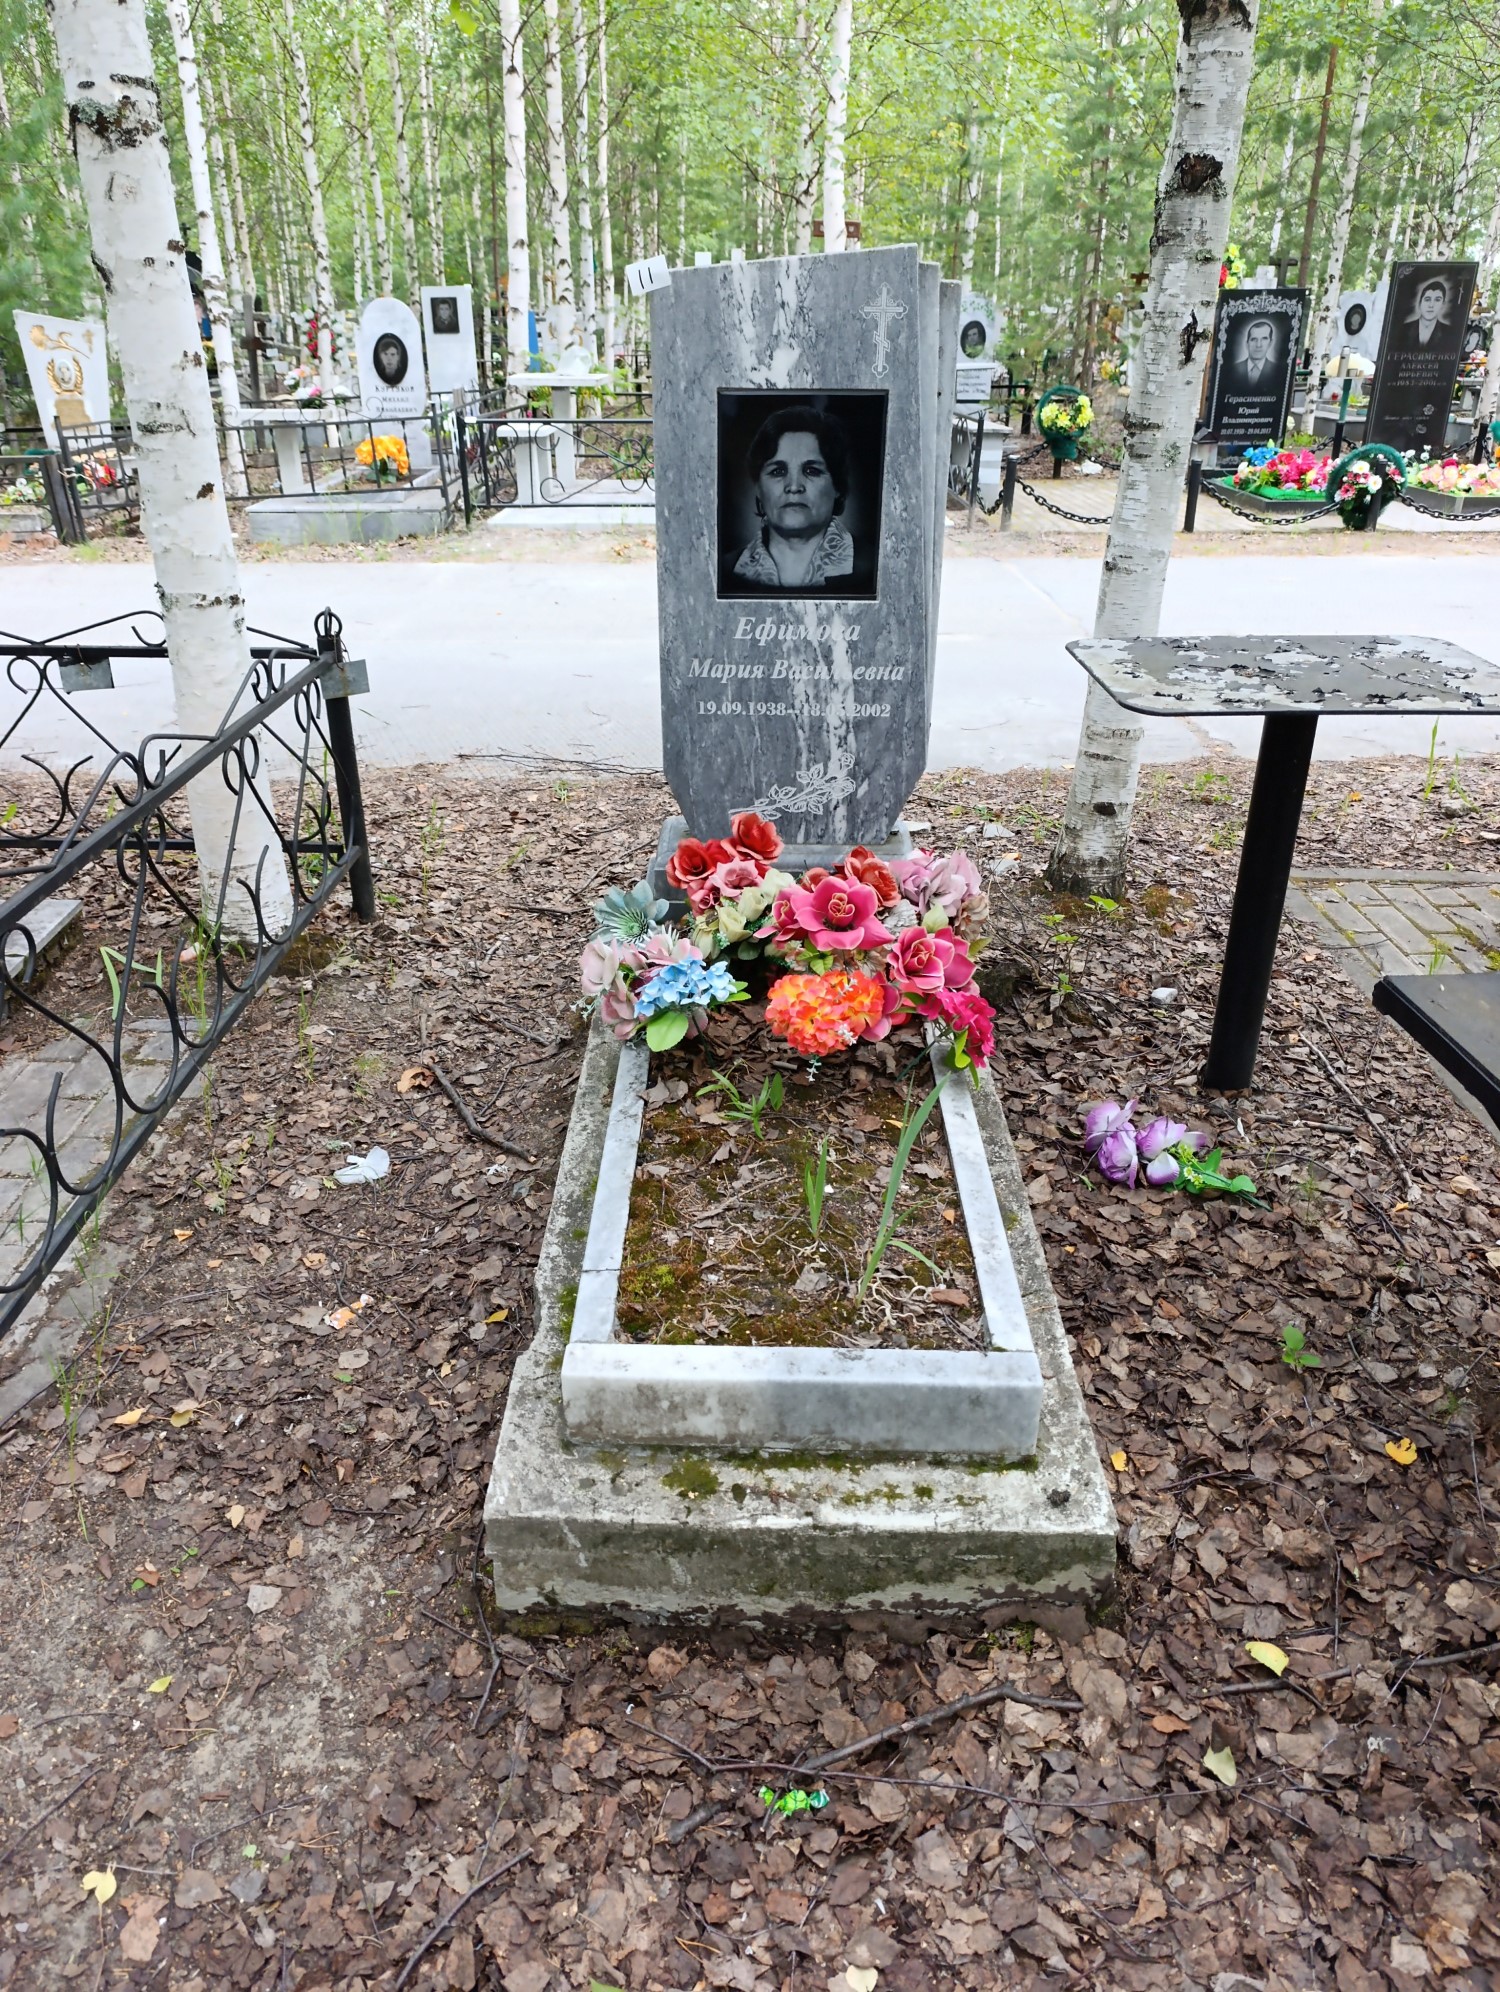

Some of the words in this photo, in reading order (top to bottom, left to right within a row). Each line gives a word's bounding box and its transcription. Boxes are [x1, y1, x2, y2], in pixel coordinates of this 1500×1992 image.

[1387, 352, 1456, 361] ГЕРАСИМЕНКО
[1224, 394, 1277, 405] Герасименко
[1237, 406, 1260, 416] Юрий
[1221, 416, 1274, 425] Владимирович
[733, 616, 862, 646] Ефимова
[687, 657, 765, 684] Мария
[770, 659, 905, 681] Васильевна
